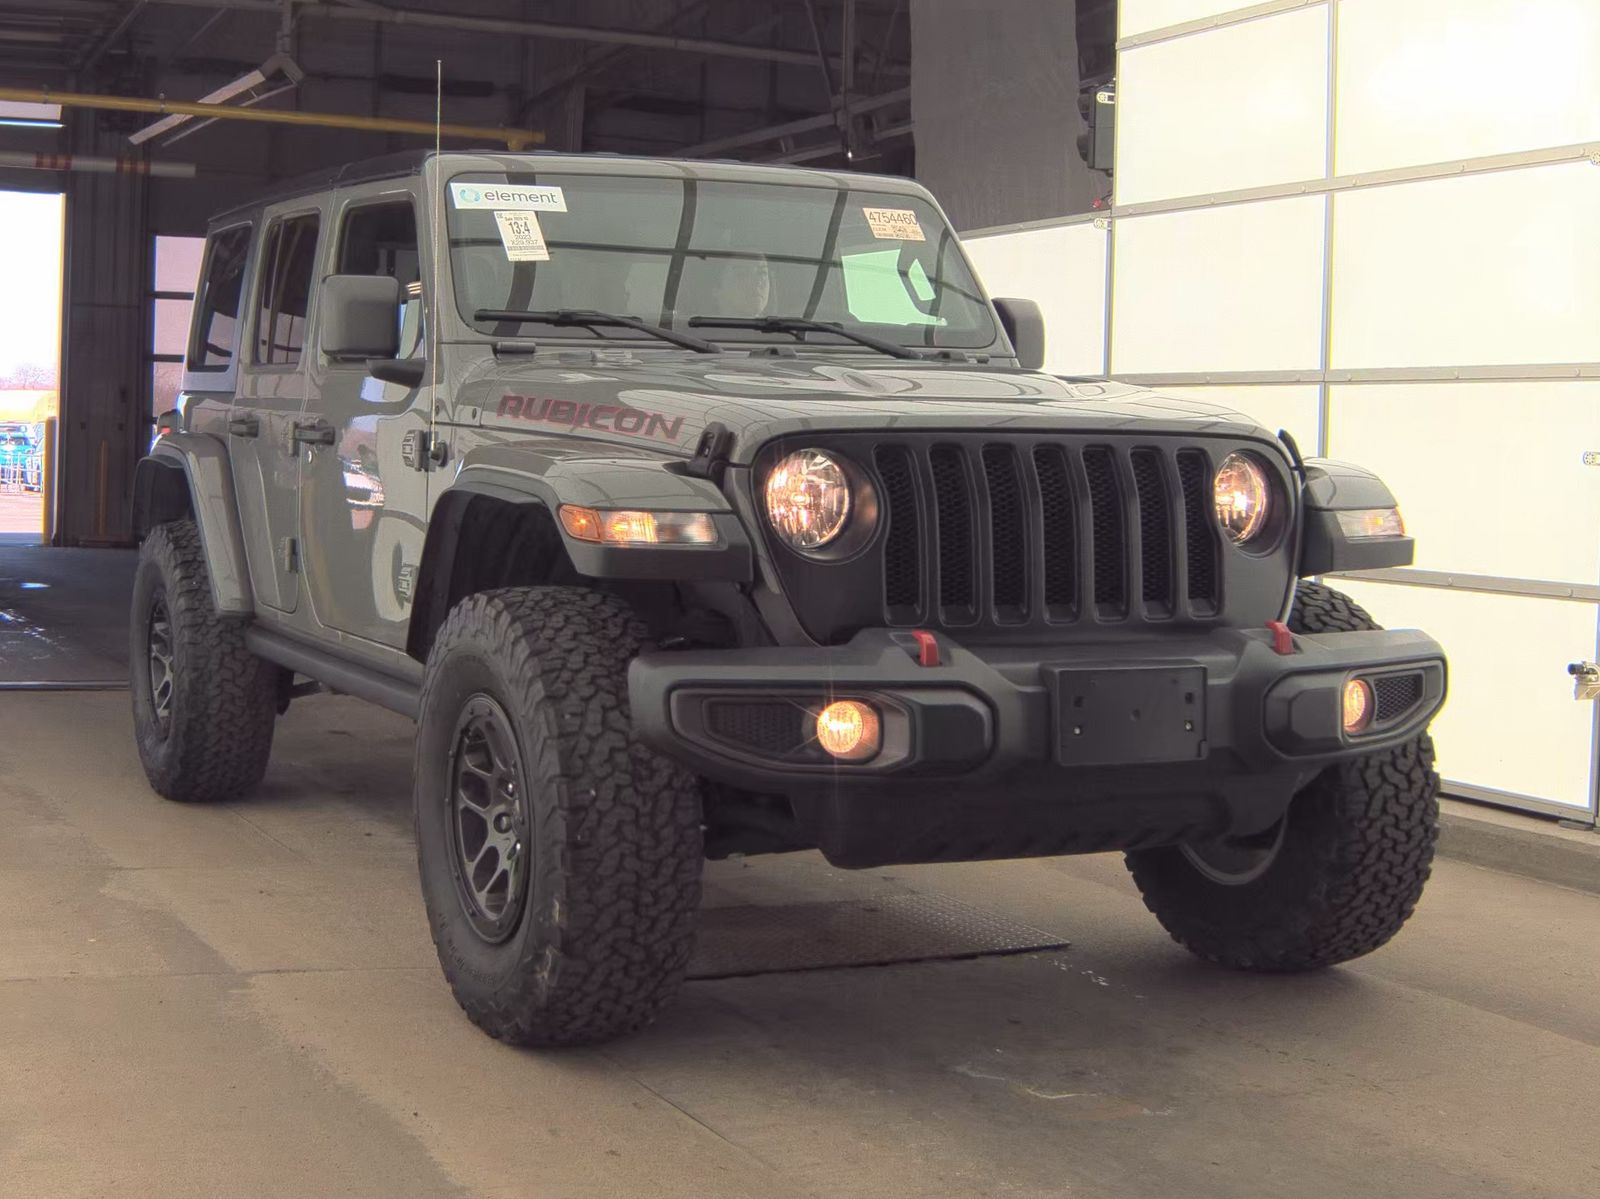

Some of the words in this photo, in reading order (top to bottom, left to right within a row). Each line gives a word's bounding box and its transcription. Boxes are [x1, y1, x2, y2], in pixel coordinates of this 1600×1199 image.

[484, 190, 558, 204] element
[869, 211, 917, 225] 4754460
[508, 221, 531, 234] 13:4
[496, 394, 685, 440] RUBICON
